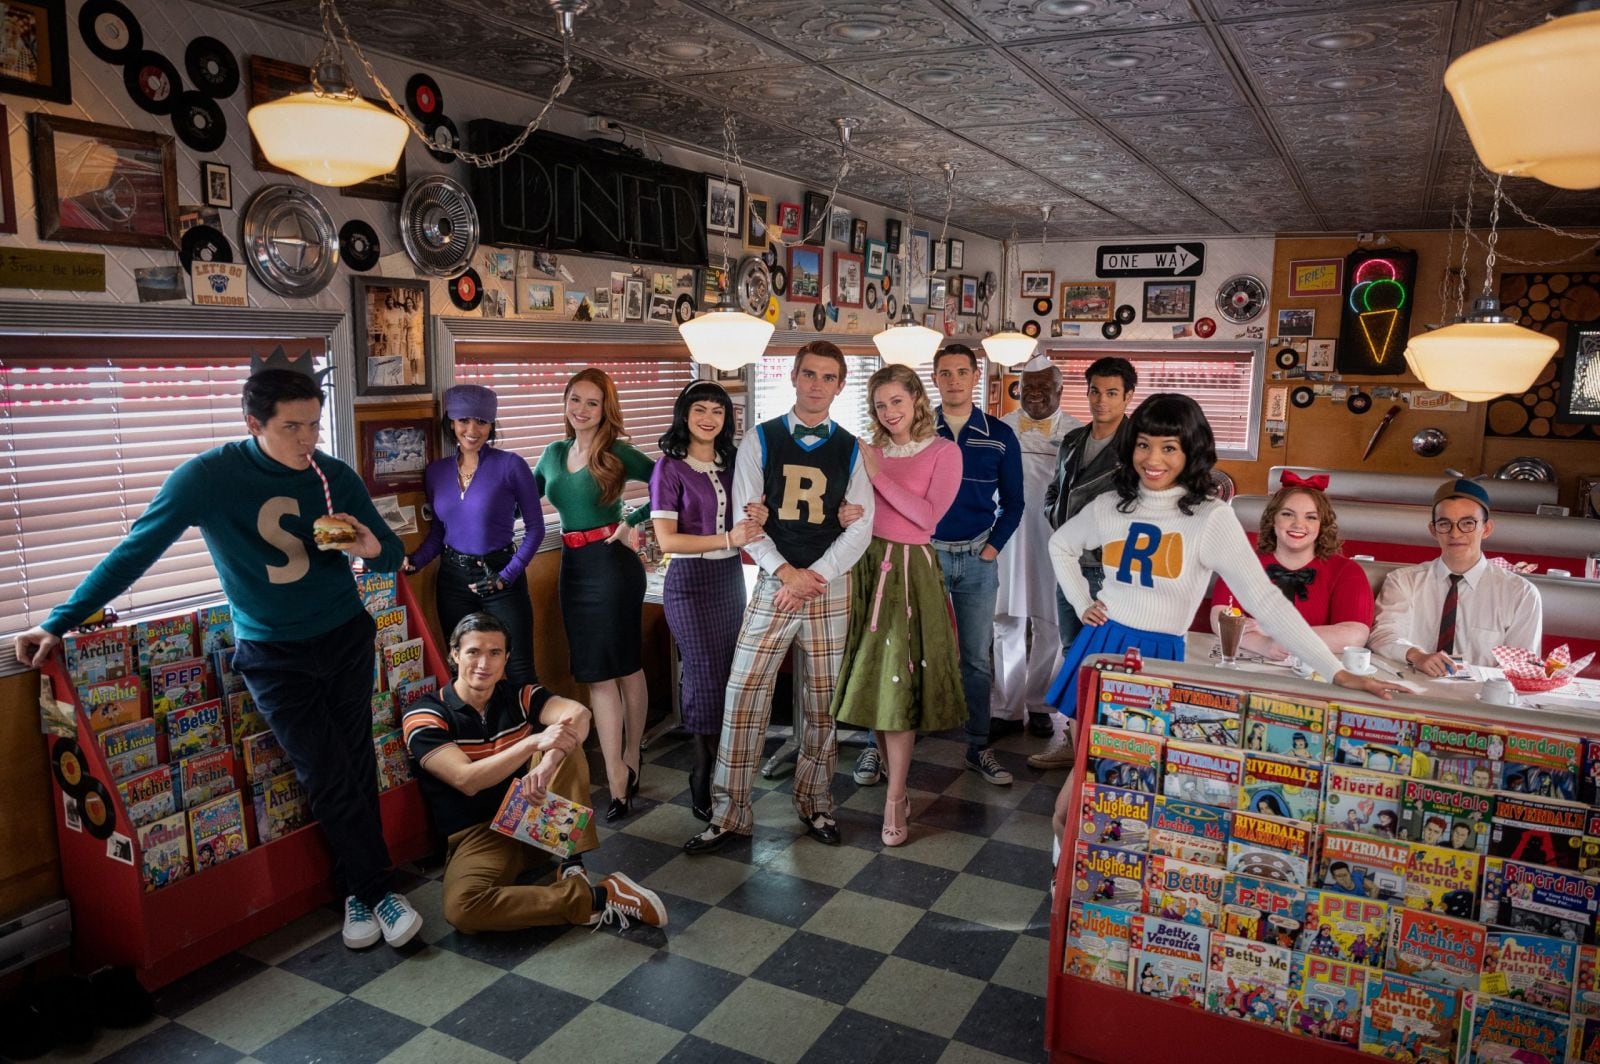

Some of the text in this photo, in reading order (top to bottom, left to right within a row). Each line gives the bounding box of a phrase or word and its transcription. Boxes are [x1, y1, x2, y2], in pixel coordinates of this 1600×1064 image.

[500, 151, 697, 253] DINER
[195, 263, 243, 278] LET'S GO
[1109, 252, 1188, 268] ONE WAY
[778, 465, 827, 523] R
[257, 496, 310, 584] S
[1117, 522, 1162, 587] R
[365, 577, 394, 598] Archie
[210, 608, 231, 624] Arc
[376, 610, 404, 632] Betty
[80, 638, 124, 661] Archie
[391, 645, 421, 668] Betty
[165, 667, 202, 687] PEP
[91, 681, 137, 704] Archie
[1171, 689, 1239, 712] RIVERDALE
[179, 706, 219, 735] Betty
[1250, 695, 1324, 722] RIVERDALE
[383, 735, 406, 759] Bet
[1092, 731, 1156, 756] Riverdale
[1507, 736, 1575, 759] verdale
[191, 765, 228, 788] Archie
[1247, 761, 1318, 784] RIVERDALE
[132, 778, 171, 803] Archie
[270, 780, 305, 808] Archi
[1332, 775, 1400, 799] Riverdal
[1406, 782, 1489, 813] Riverdale
[1094, 792, 1149, 819] Jughead
[1496, 802, 1586, 830] RIVERDALE
[1157, 815, 1194, 833] Archie
[1205, 823, 1225, 841] Me
[1235, 816, 1306, 841] RIVERDALE
[1327, 837, 1408, 864] RIVERDALE
[1088, 850, 1143, 880] Jughead
[1406, 852, 1473, 881] Archie's
[1164, 869, 1223, 901] Betty
[1504, 864, 1596, 900] Riverdale
[1239, 888, 1289, 914] PEP
[1323, 897, 1383, 921] PEP
[1082, 910, 1130, 940] Jughea
[1158, 923, 1199, 942] Betty &
[1147, 932, 1201, 952] Veronica
[1401, 941, 1431, 958] Pals
[1406, 922, 1476, 958] Archie's
[1225, 945, 1287, 971] Betty Me
[1502, 944, 1567, 970] Archie's
[1501, 962, 1525, 974] Pals
[1538, 966, 1564, 980] Gals
[1370, 999, 1398, 1015] Pals
[1340, 1026, 1355, 1038] 15
[1485, 1009, 1556, 1042] Archie's
